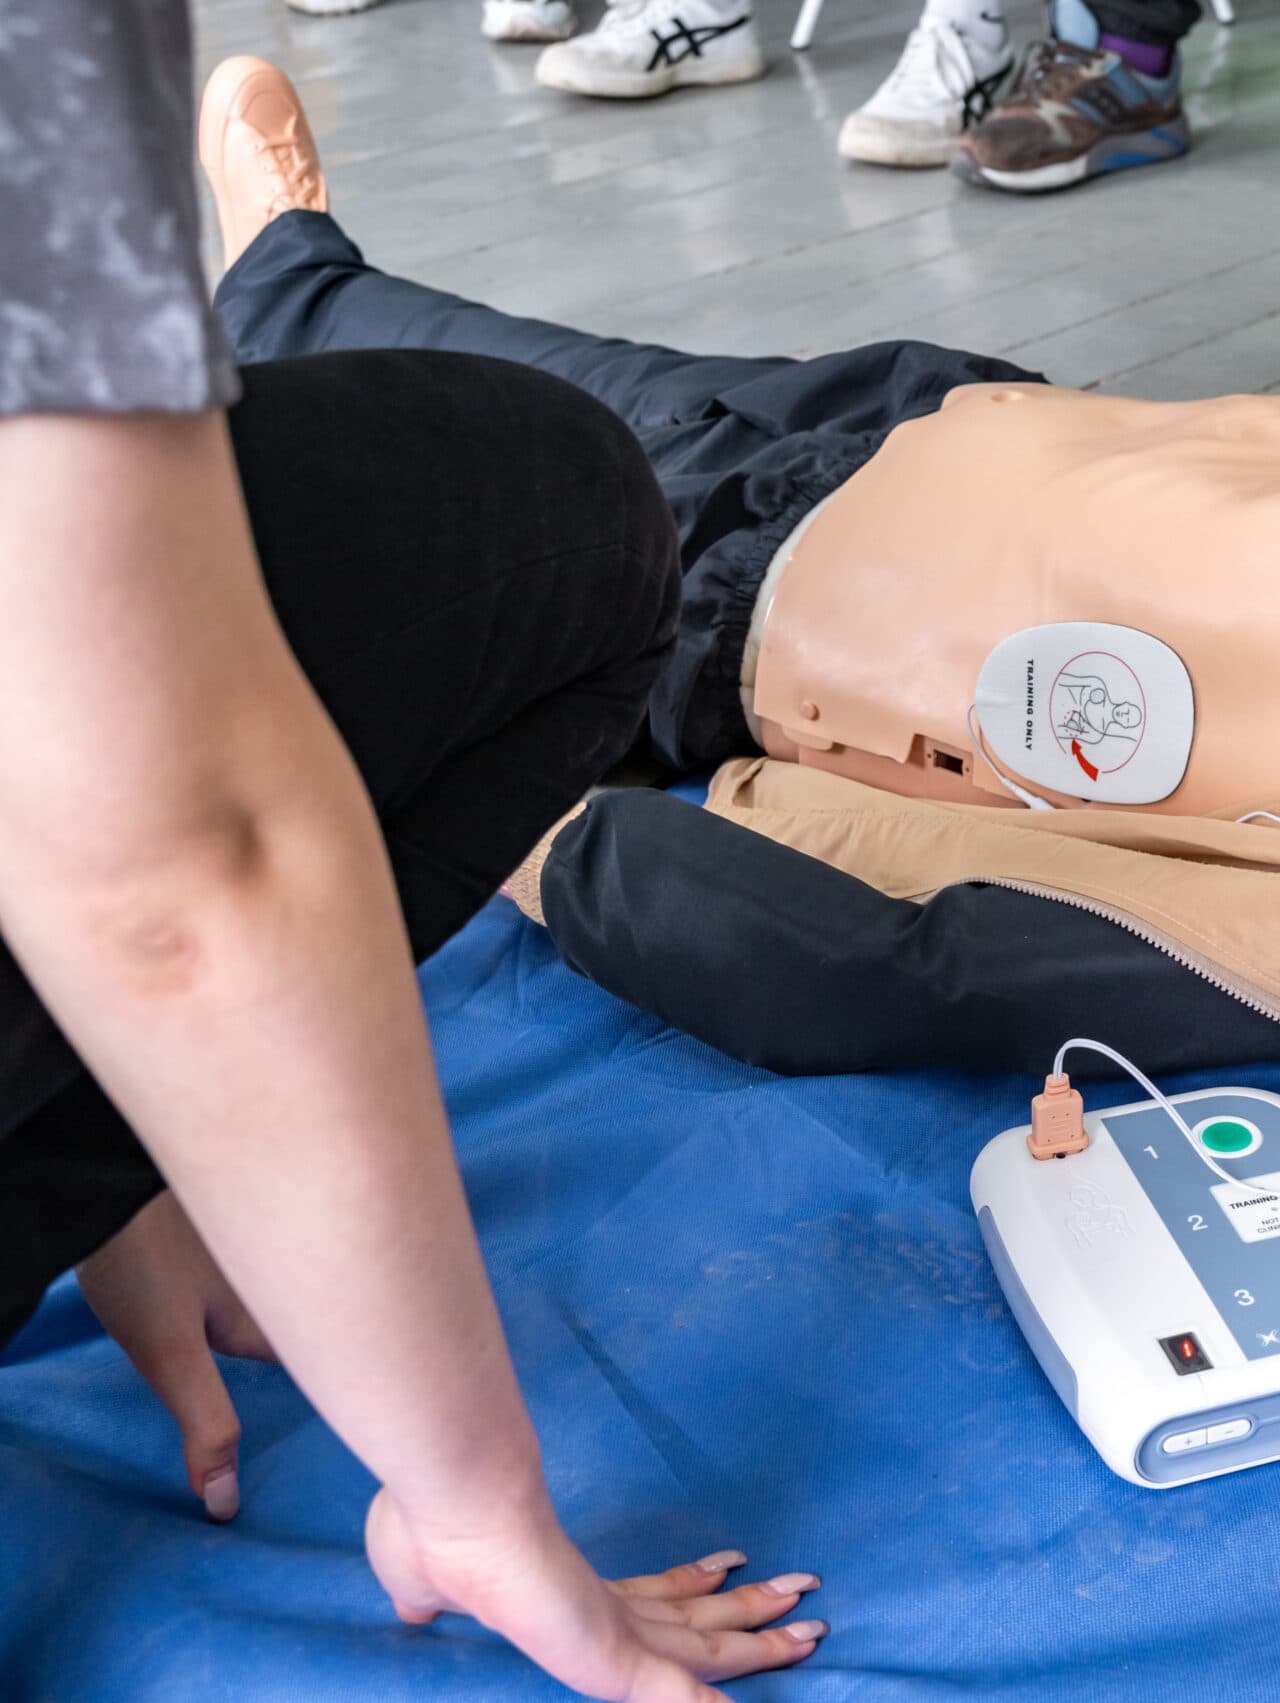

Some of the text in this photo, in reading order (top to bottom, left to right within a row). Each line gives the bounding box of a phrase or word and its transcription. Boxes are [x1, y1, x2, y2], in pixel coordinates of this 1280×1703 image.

[1026, 659, 1034, 715] TRAINING
[1143, 1145, 1159, 1160] 1
[1229, 1195, 1279, 1210] TRAINING
[1187, 1214, 1209, 1231] 2
[1261, 1216, 1280, 1226] NOT
[1233, 1289, 1255, 1306] 3
